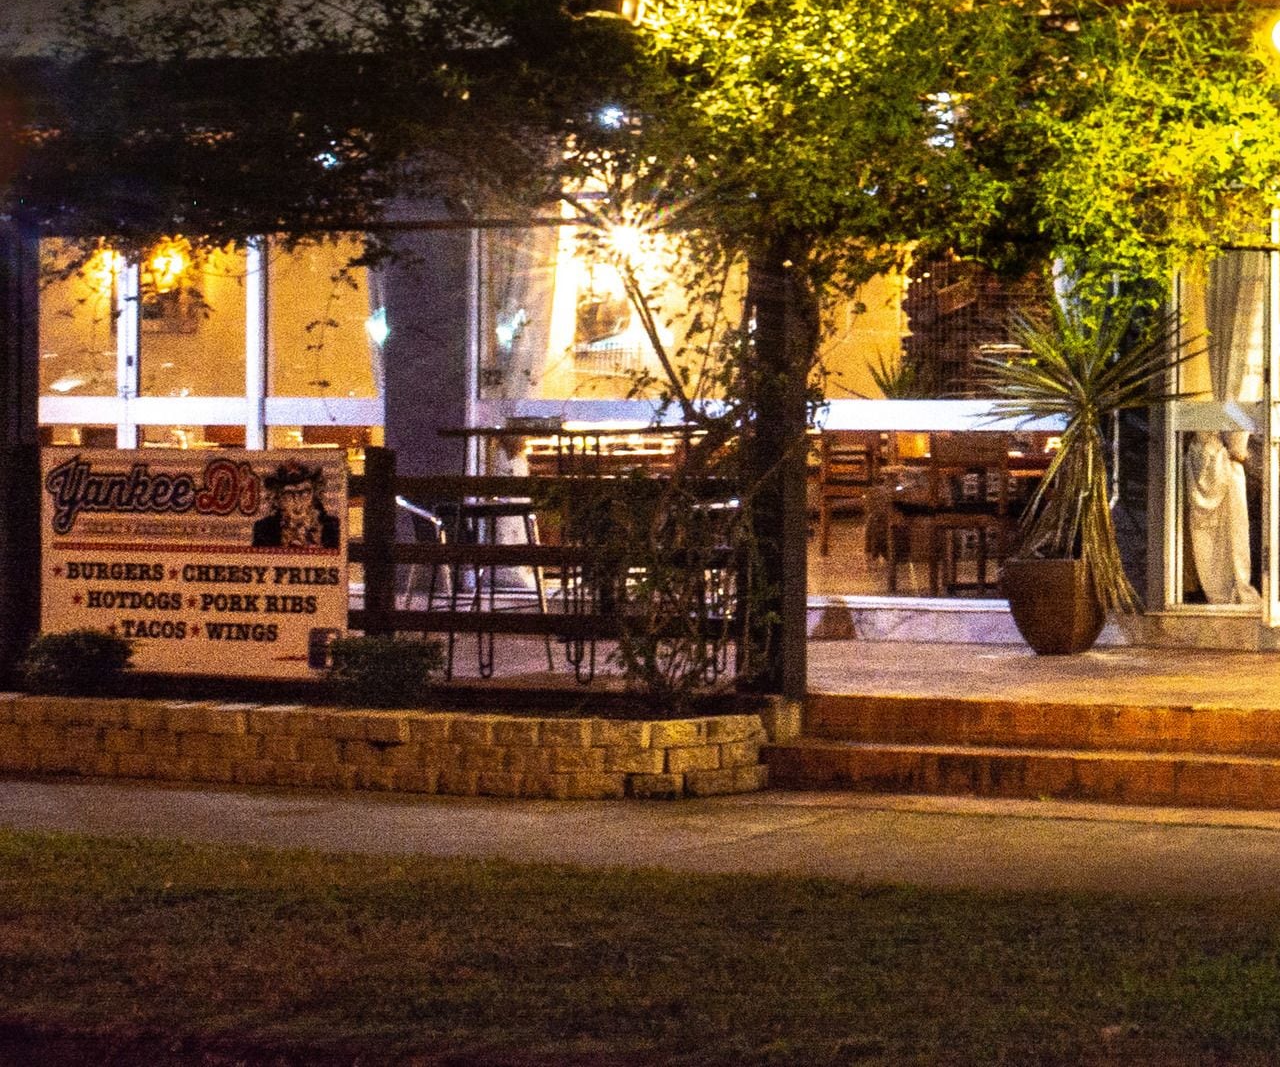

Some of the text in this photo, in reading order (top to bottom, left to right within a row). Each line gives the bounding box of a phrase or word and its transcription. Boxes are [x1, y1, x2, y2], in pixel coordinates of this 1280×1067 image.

[46, 454, 262, 536] Yankee D's
[66, 562, 340, 586] BURGERS CHEESY FRIES
[86, 590, 318, 615] HOTDOGS PORK RIBS
[121, 619, 279, 643] TACOS WINGS
